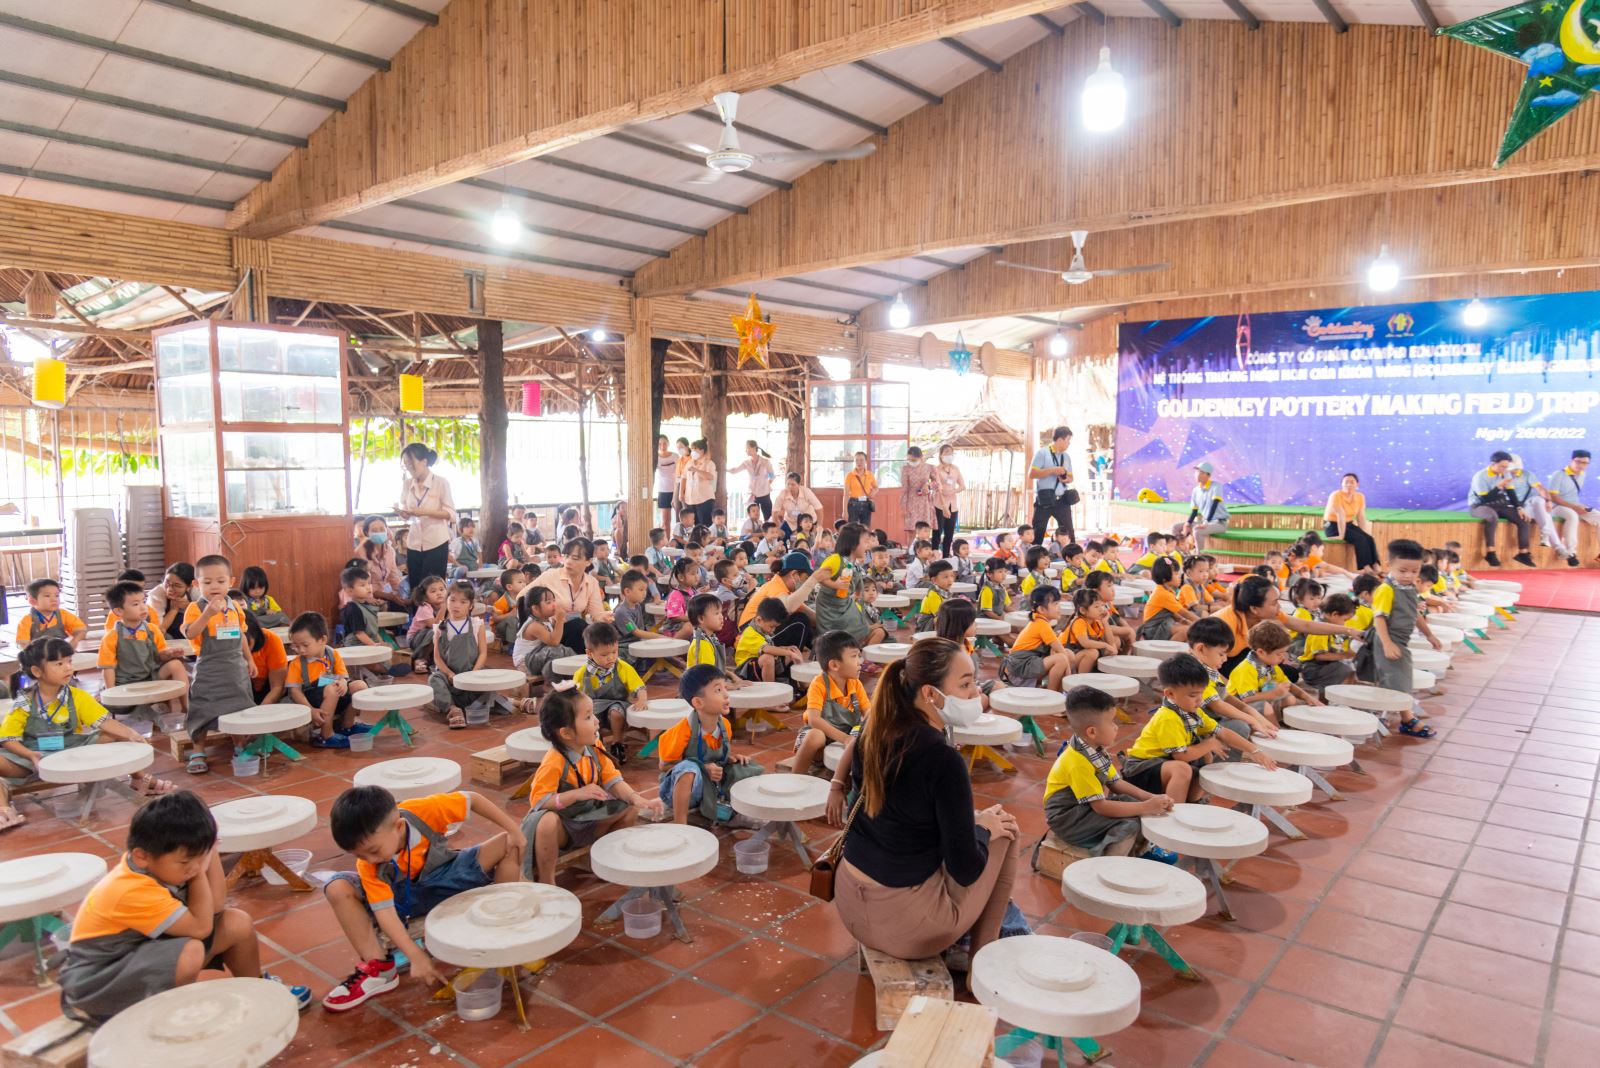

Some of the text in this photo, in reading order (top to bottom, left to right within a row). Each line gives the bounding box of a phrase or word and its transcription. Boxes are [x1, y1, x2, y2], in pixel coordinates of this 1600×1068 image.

[1248, 351, 1276, 364] CÔNG
[1279, 351, 1294, 364] TY
[1157, 391, 1599, 418] GOLDENKEY POTTERY MAKING FIELD TRIP
[1475, 426, 1586, 441] Ngày 26/8/2022
